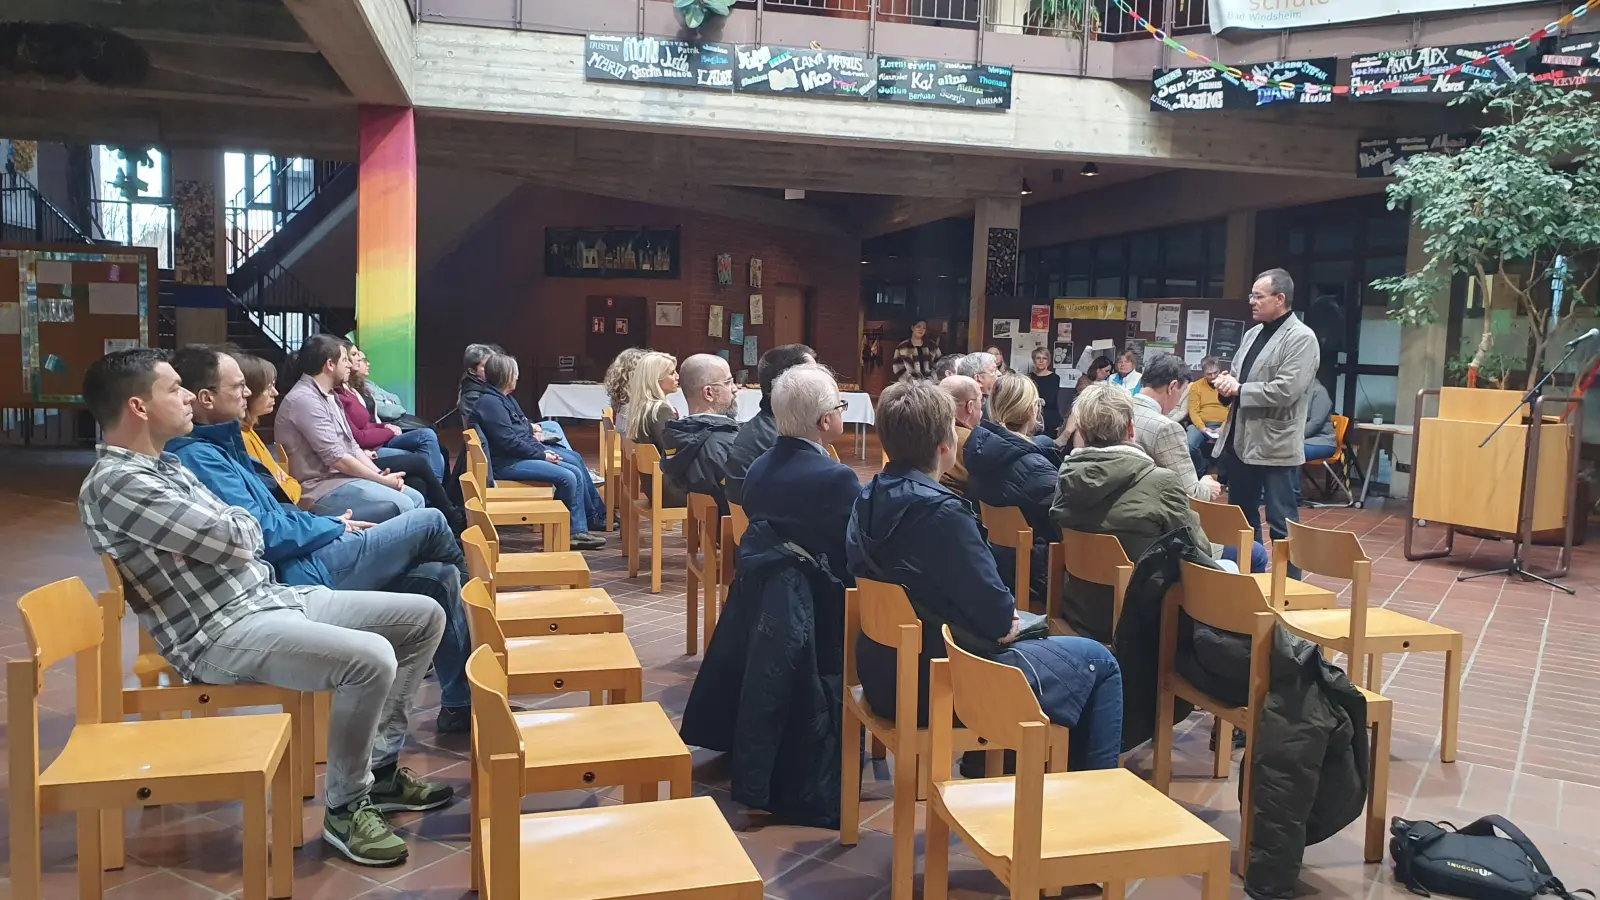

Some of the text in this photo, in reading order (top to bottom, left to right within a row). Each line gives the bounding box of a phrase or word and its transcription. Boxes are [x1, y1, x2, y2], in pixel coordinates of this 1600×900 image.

[1249, 0, 1330, 11] scu
[1227, 10, 1302, 21] Bad Windsheim
[586, 52, 628, 80] MARIA
[792, 52, 825, 72] LANA
[978, 75, 1007, 88] Thomas
[1432, 75, 1466, 92] Nora
[1553, 76, 1588, 87] KEVIN
[1158, 81, 1186, 98] Jan
[975, 96, 1003, 106] ADRIAN
